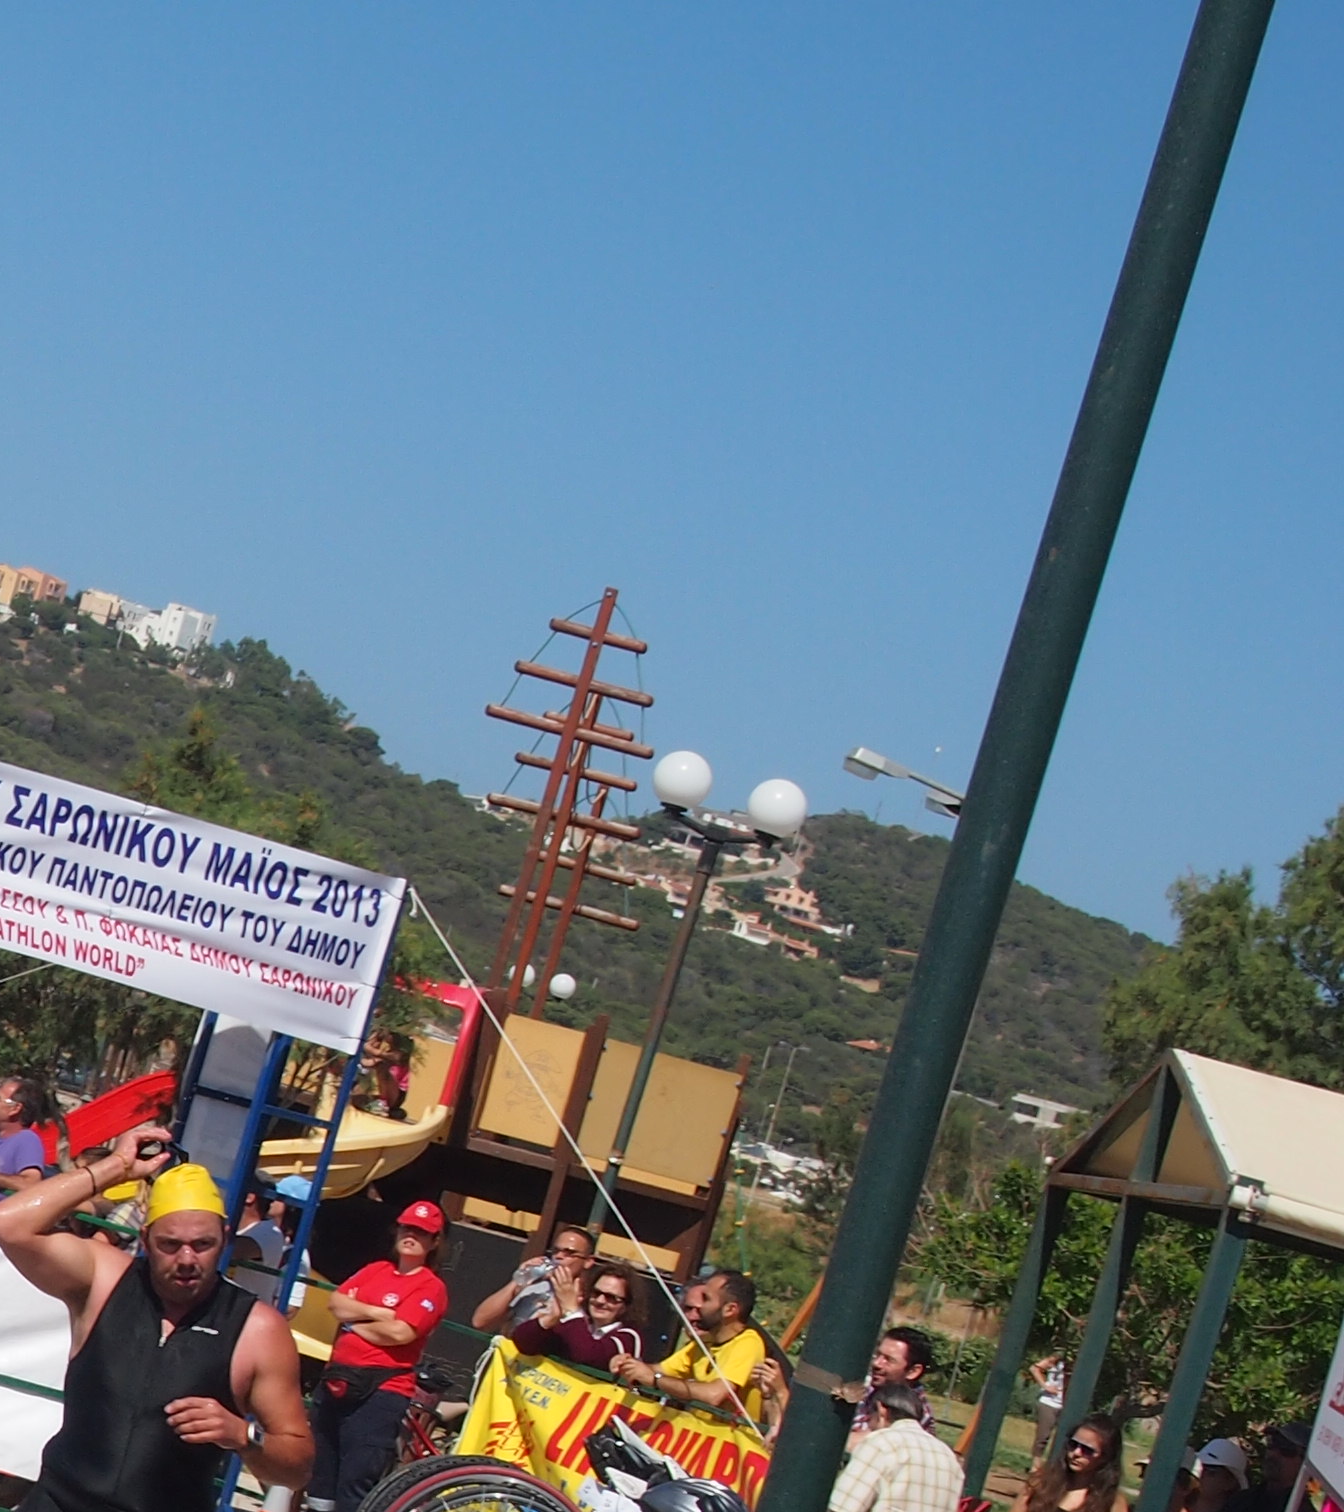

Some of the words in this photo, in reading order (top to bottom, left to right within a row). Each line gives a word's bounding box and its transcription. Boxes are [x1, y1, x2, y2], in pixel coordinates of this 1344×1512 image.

[5, 784, 201, 874] ΣΑΡΩΝΙΚΟΥ
[204, 842, 310, 906] ΜΑΪΟΣ
[311, 874, 381, 927] 2013
[47, 858, 235, 932] ΠΑΝΤΟΠΩΛΕΙΟΥ
[239, 911, 286, 947] ΤΟΥ
[286, 925, 367, 969] ΔΗΜΟΥ
[56, 905, 69, 925] &
